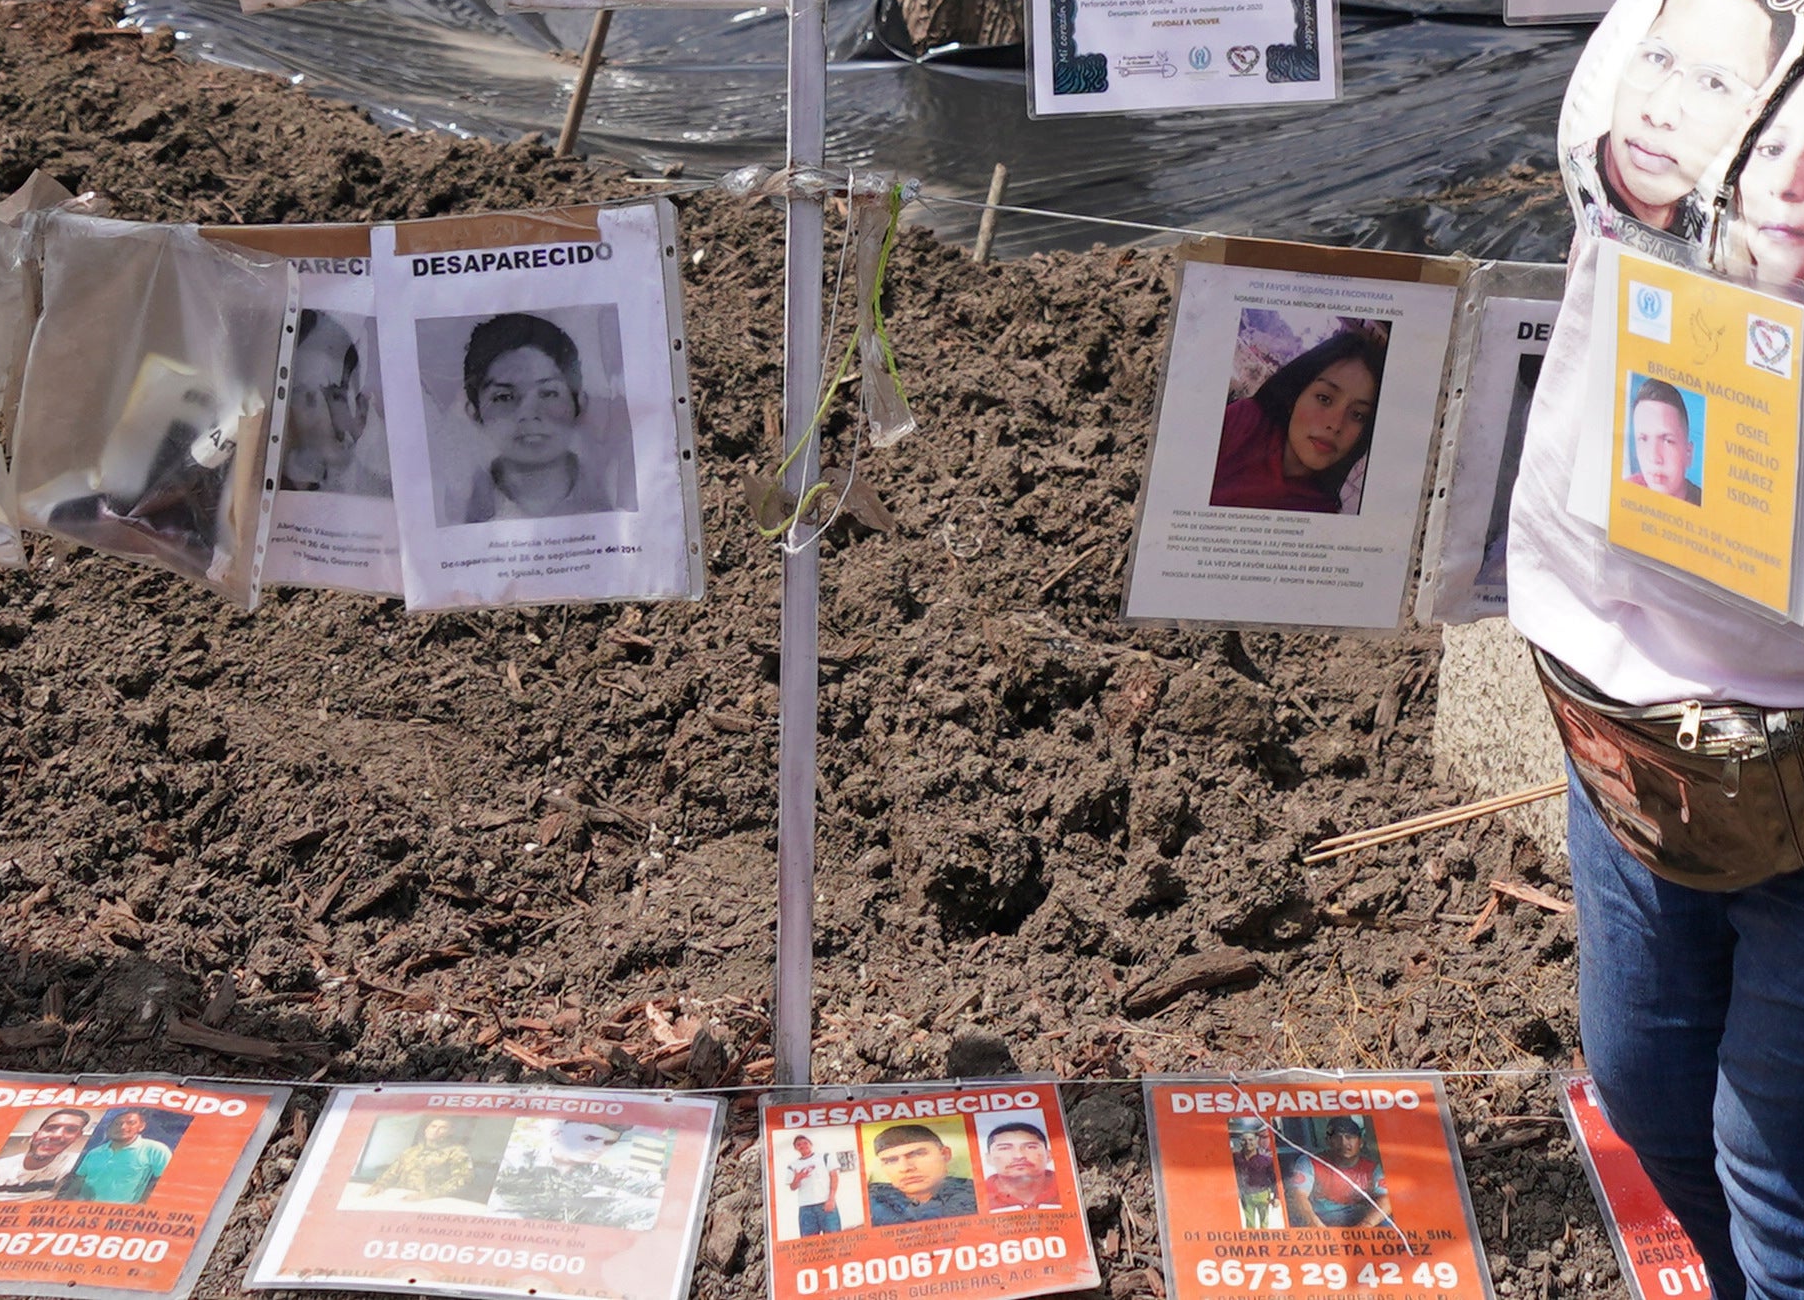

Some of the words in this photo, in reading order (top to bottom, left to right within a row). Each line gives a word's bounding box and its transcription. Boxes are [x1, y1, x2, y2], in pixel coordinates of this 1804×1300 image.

[412, 242, 614, 277] DESAPARECIDO
[1648, 361, 1702, 390] BRIGADA
[1706, 381, 1770, 415] NACIONAL
[1736, 423, 1770, 446] OSIEL
[1725, 440, 1779, 472] VIRGILIO
[1728, 463, 1774, 493] JUÁREZ
[1727, 486, 1771, 515] ISIDRO.
[428, 1094, 624, 1116] DESAPARECIDO
[782, 1091, 1039, 1130] DESAPARECIDO
[1171, 1088, 1420, 1114] DESAPARECIDO
[1184, 1231, 1200, 1241] 01
[1207, 1230, 1291, 1242] DICIEMBRE
[1297, 1230, 1336, 1243] 2018,
[1427, 1229, 1456, 1241] SIN.
[1215, 1245, 1271, 1258] OMAR
[1277, 1244, 1365, 1258] ZAZUETA
[363, 1239, 586, 1274] 018006703600
[796, 1235, 1067, 1296] 018006703600
[1197, 1259, 1292, 1291] 6673
[1300, 1263, 1348, 1288] 29
[1357, 1262, 1403, 1288] 42
[1412, 1262, 1458, 1289] 49
